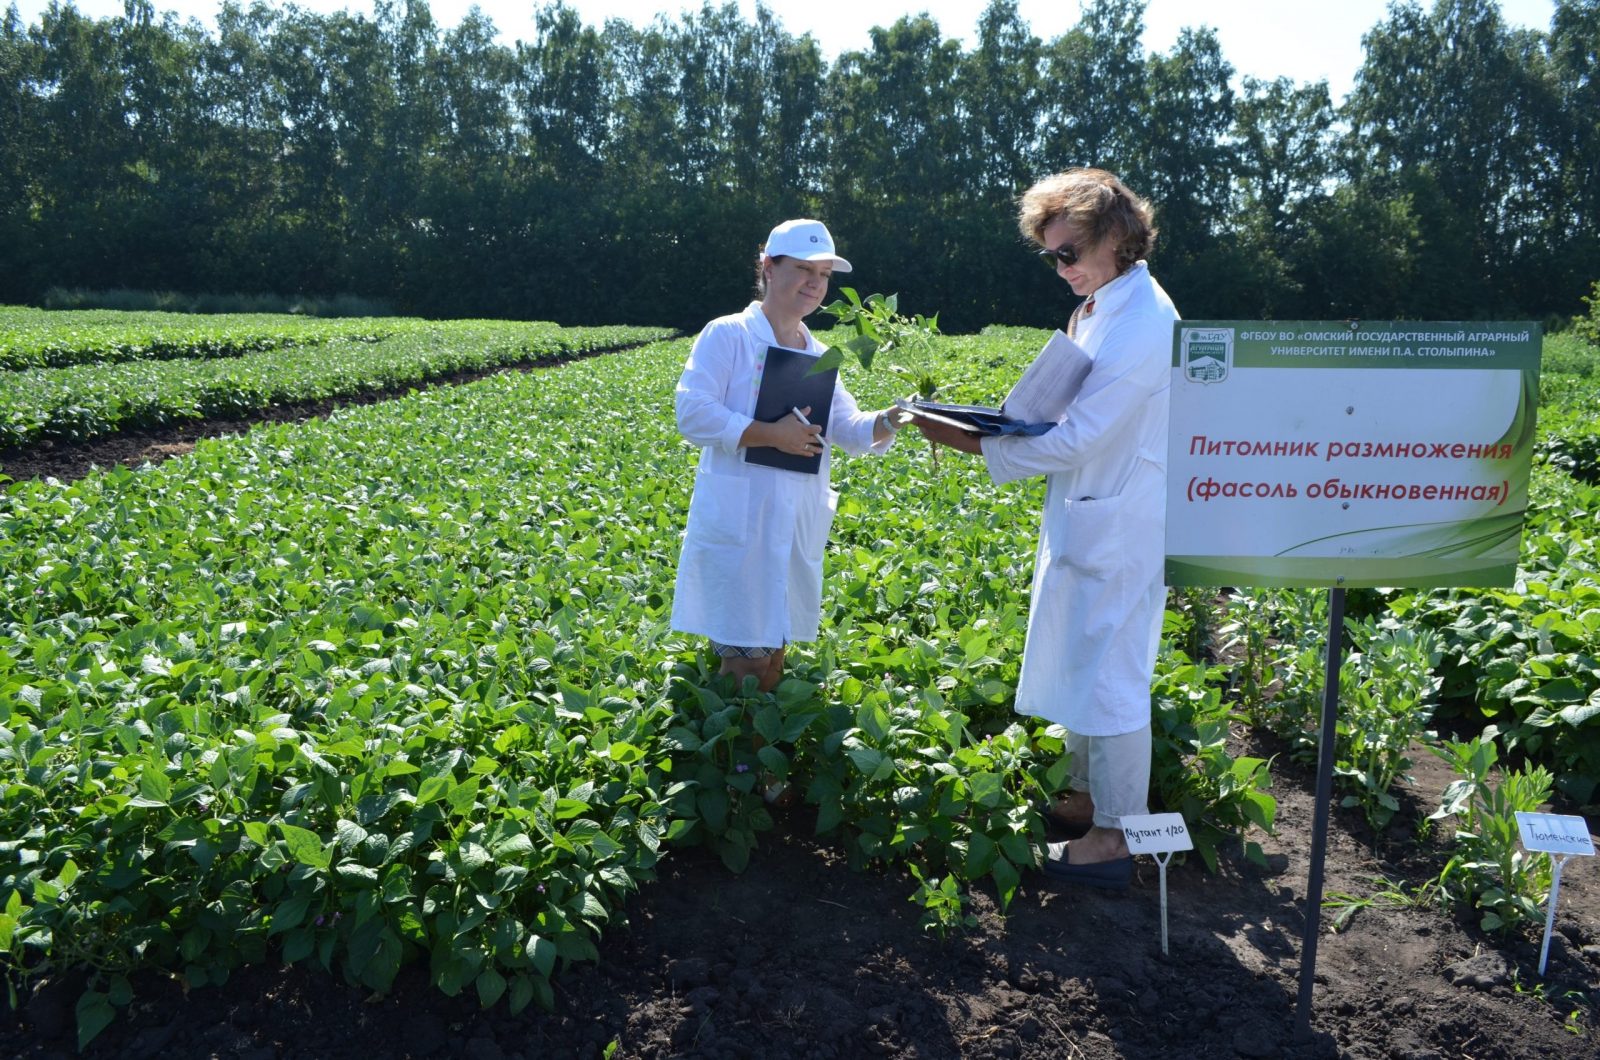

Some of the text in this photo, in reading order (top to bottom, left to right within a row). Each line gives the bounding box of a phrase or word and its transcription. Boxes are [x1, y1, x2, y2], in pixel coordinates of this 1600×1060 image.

[1240, 330, 1529, 343] ФГБОУ ВО «ОМСКИЙ ГОСУДАРСТВЕННЫЙ АГРАРНЫЙ
[1270, 346, 1496, 357] УНИВЕРСИТЕТ ИМЕНИ П.А. СТОЛЫПИНА»
[1189, 435, 1513, 462] Питомник размножения
[1187, 476, 1509, 507] (фасоль обыкновенная)
[1125, 824, 1185, 844] Мутант 1/20
